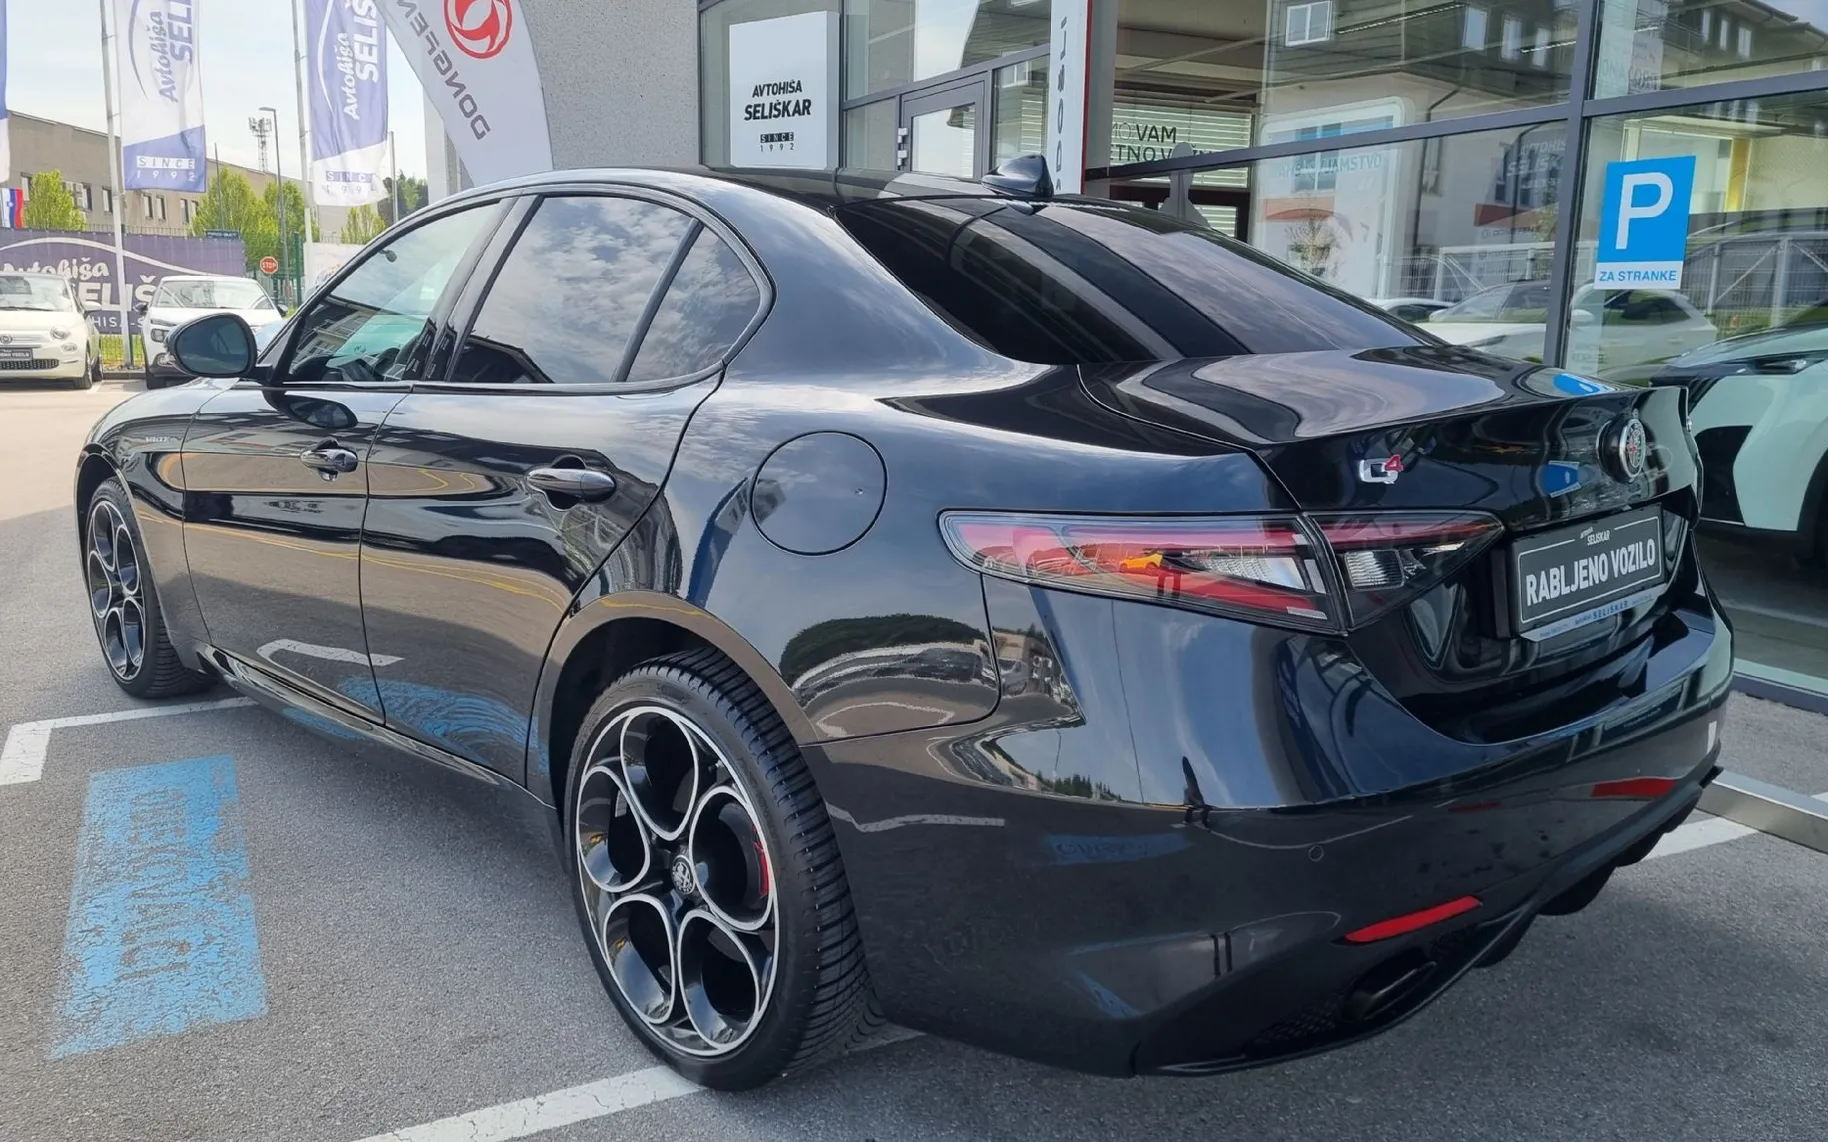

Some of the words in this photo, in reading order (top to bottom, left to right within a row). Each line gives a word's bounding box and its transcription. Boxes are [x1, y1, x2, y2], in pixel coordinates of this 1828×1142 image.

[752, 79, 802, 98] AVTOHIŠA
[744, 99, 812, 121] SELIŠKAR
[761, 133, 794, 143] SINCE
[1136, 124, 1177, 144] VAM
[760, 143, 794, 152] 1992
[139, 157, 195, 168] SINCE
[137, 170, 196, 182] 1992
[1615, 171, 1674, 250] P
[262, 261, 277, 270] STOP
[1600, 271, 1615, 282] ZA
[1618, 270, 1677, 282] STRANKE
[1526, 552, 1609, 606] RABLJENO
[1610, 538, 1656, 579] VOZILO
